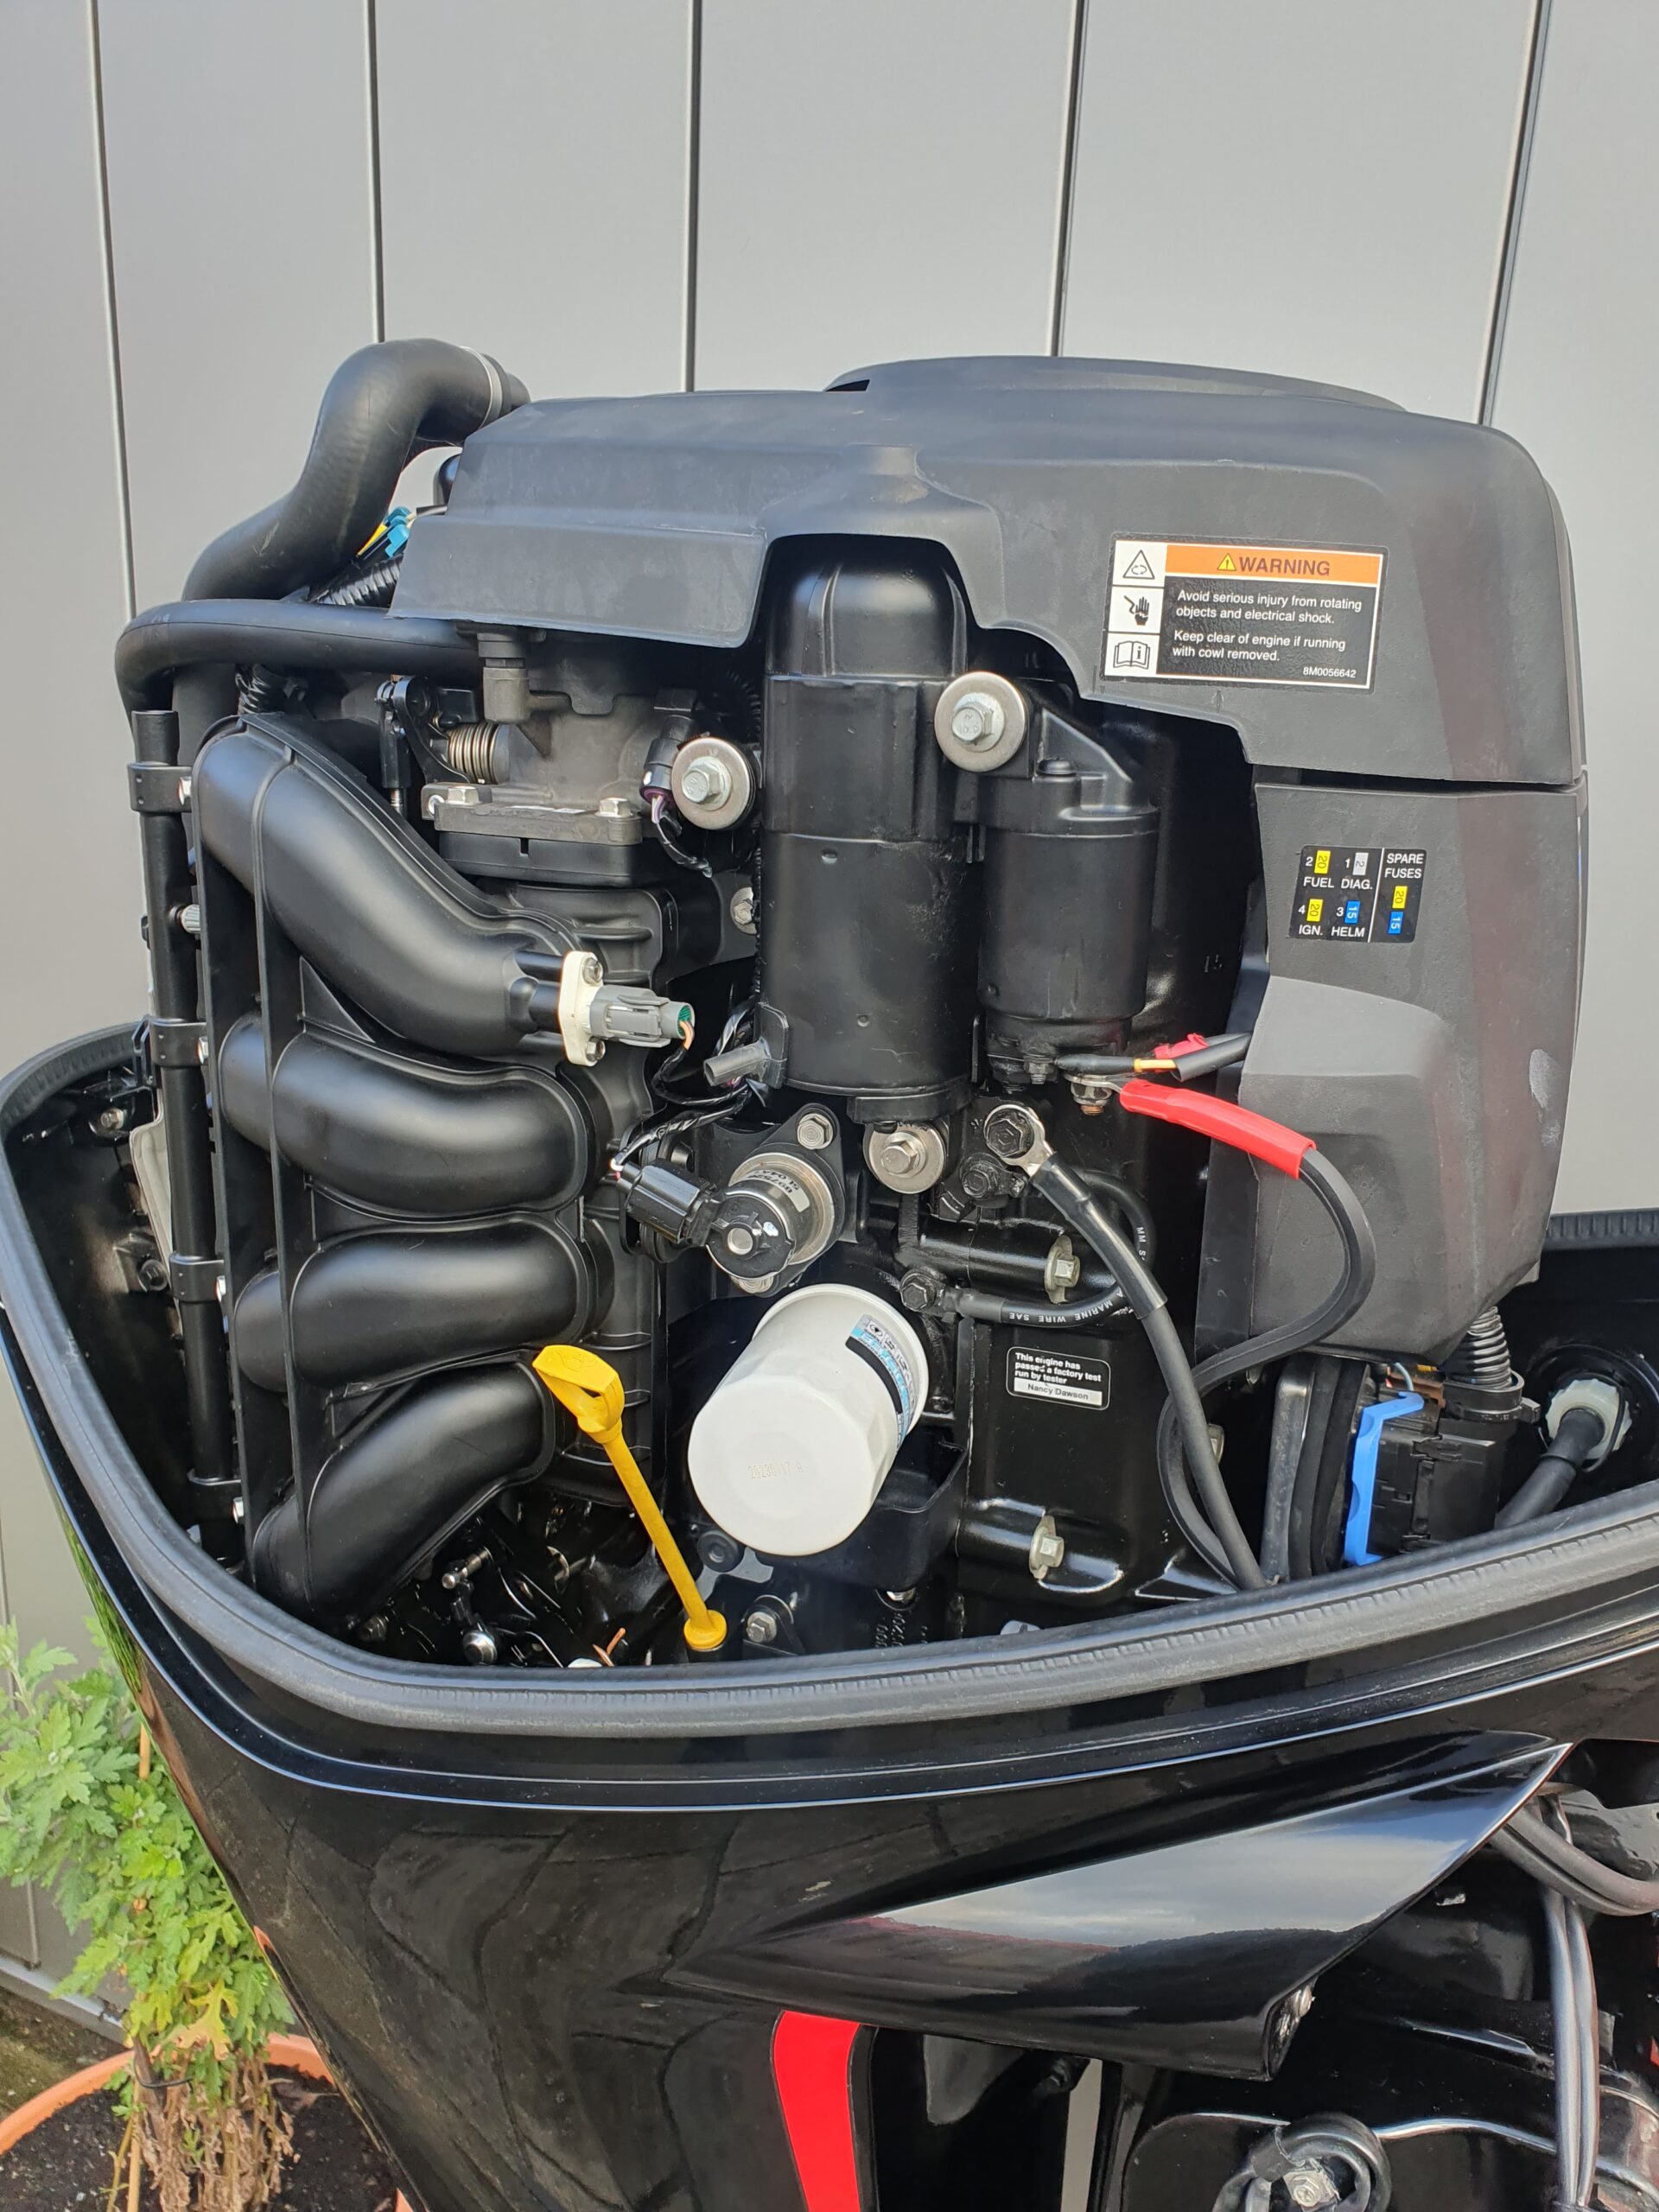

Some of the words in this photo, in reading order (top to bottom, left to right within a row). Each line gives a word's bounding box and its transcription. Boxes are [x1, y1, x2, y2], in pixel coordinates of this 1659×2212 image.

[1239, 556, 1331, 576] WARNING
[1178, 589, 1209, 603] Avoid
[1212, 591, 1254, 604] serious
[1257, 594, 1287, 608] injury
[1291, 594, 1317, 607] from
[1320, 597, 1362, 612] rotating
[1176, 607, 1217, 621] objects
[1220, 607, 1242, 620] and
[1245, 609, 1295, 622] electrical
[1298, 612, 1334, 624] shock.
[1174, 630, 1204, 643] Keep
[1207, 632, 1235, 644] clear
[1237, 633, 1250, 645] of
[1252, 635, 1290, 649] engine
[1294, 635, 1301, 646] if
[1304, 638, 1345, 652] running
[1173, 645, 1195, 658] with
[1198, 647, 1224, 658] cowl
[1227, 649, 1280, 662] removed.
[1303, 666, 1357, 678] 8M0056642
[1306, 857, 1313, 867] 2
[1316, 855, 1328, 869] 20
[1344, 858, 1351, 868] 1
[1387, 853, 1424, 864] SPARE
[1384, 868, 1422, 879] FUSES
[1303, 877, 1335, 888] FUEL
[1341, 879, 1373, 890] DIAG.
[1395, 890, 1405, 904] 20
[1298, 905, 1306, 915] 4
[1309, 904, 1319, 917] 20
[1336, 907, 1344, 917] 3
[1347, 906, 1357, 918] 15
[1390, 917, 1402, 930] 15
[1299, 925, 1323, 936] IGN.
[1331, 926, 1365, 938] HELM
[1135, 1226, 1147, 1243] MM
[1008, 1313, 1031, 1321] SAE
[1074, 1300, 1113, 1321] MARINE
[1015, 1352, 1033, 1363] This
[1035, 1356, 1064, 1368] engine
[1065, 1360, 1081, 1370] has
[1031, 1371, 1041, 1382] by
[1043, 1374, 1067, 1384] tester
[1054, 1366, 1084, 1381] factory
[1085, 1372, 1102, 1382] test
[1027, 1383, 1053, 1395] Nancy
[1055, 1388, 1089, 1401] Dawson
